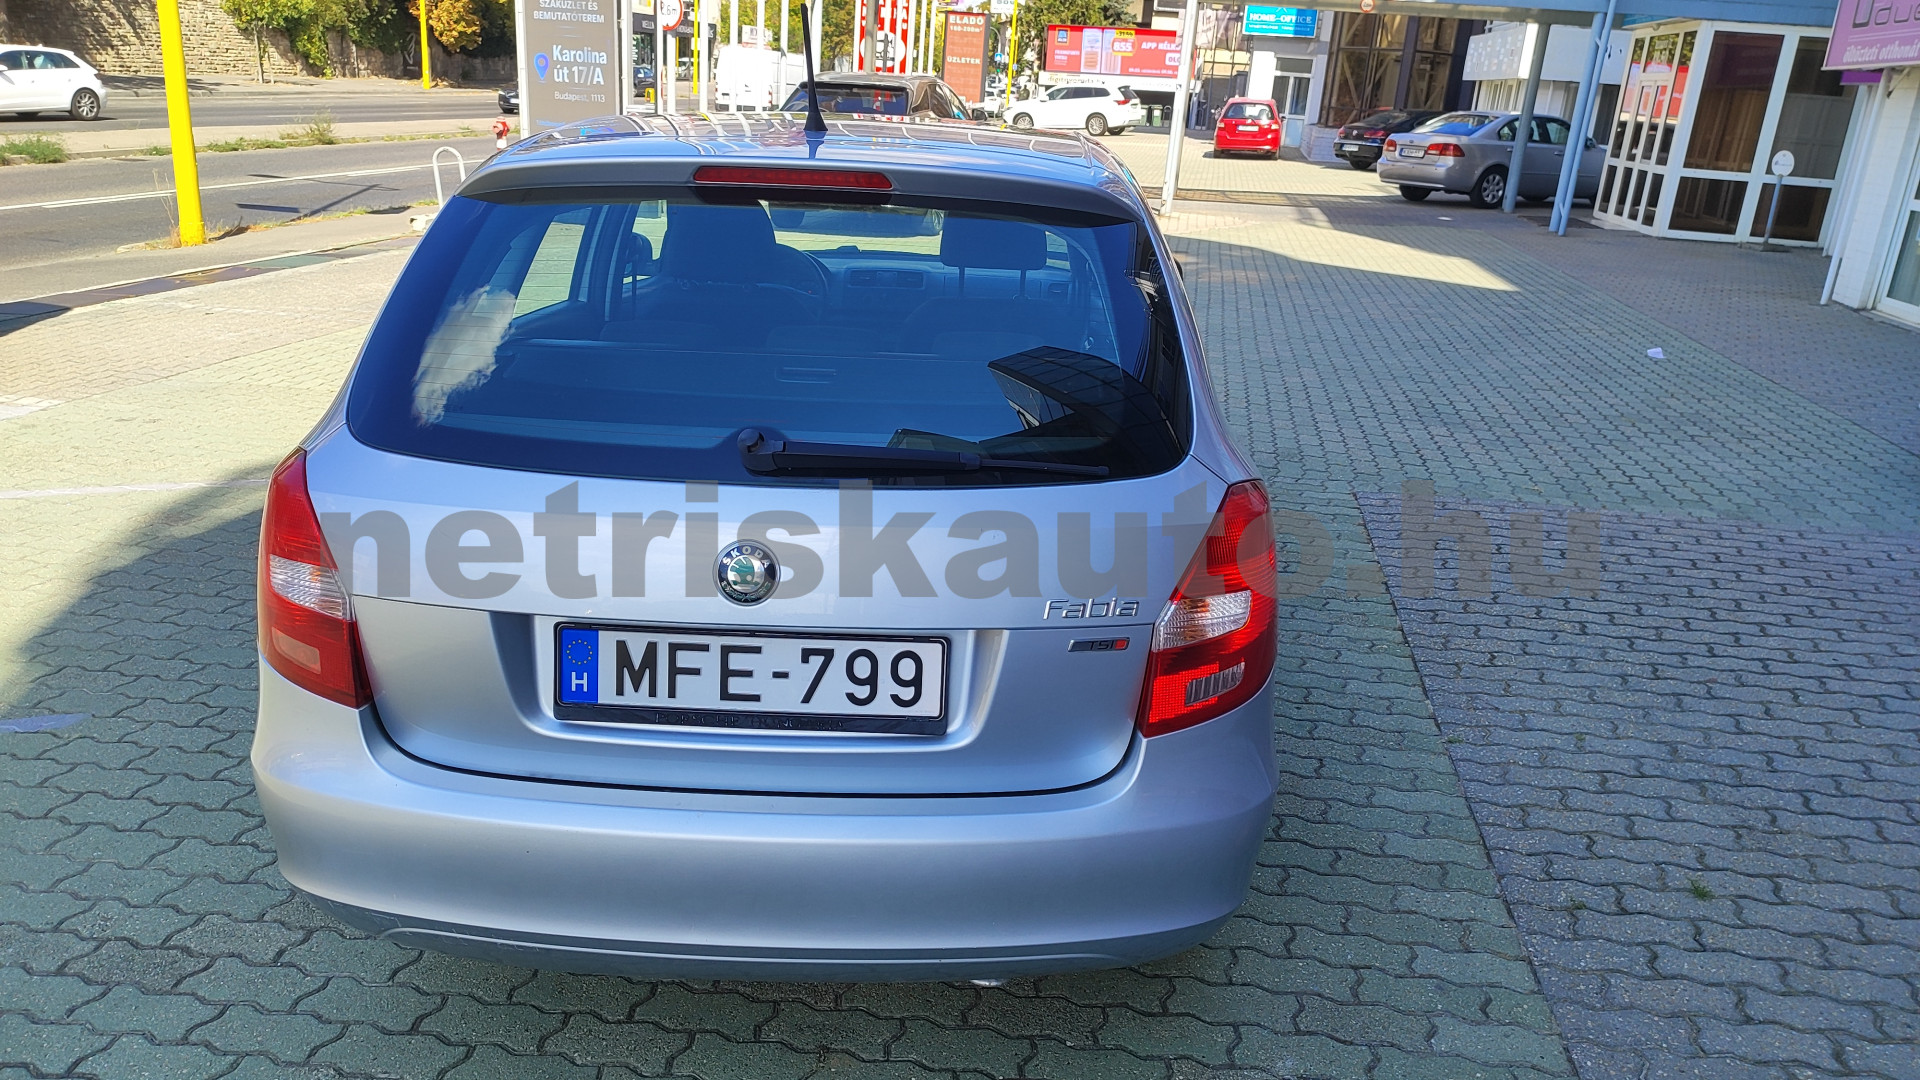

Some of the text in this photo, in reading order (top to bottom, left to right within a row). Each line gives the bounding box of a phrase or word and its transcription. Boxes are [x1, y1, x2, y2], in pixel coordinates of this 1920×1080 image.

[533, 10, 605, 23] BEMUTATÓTEREM
[552, 44, 607, 64] Karolina
[553, 64, 605, 86] út 17/A
[591, 94, 605, 103] 1113
[1043, 598, 1140, 620] Fabia
[571, 671, 588, 693] H
[614, 639, 924, 708] MFE-799
